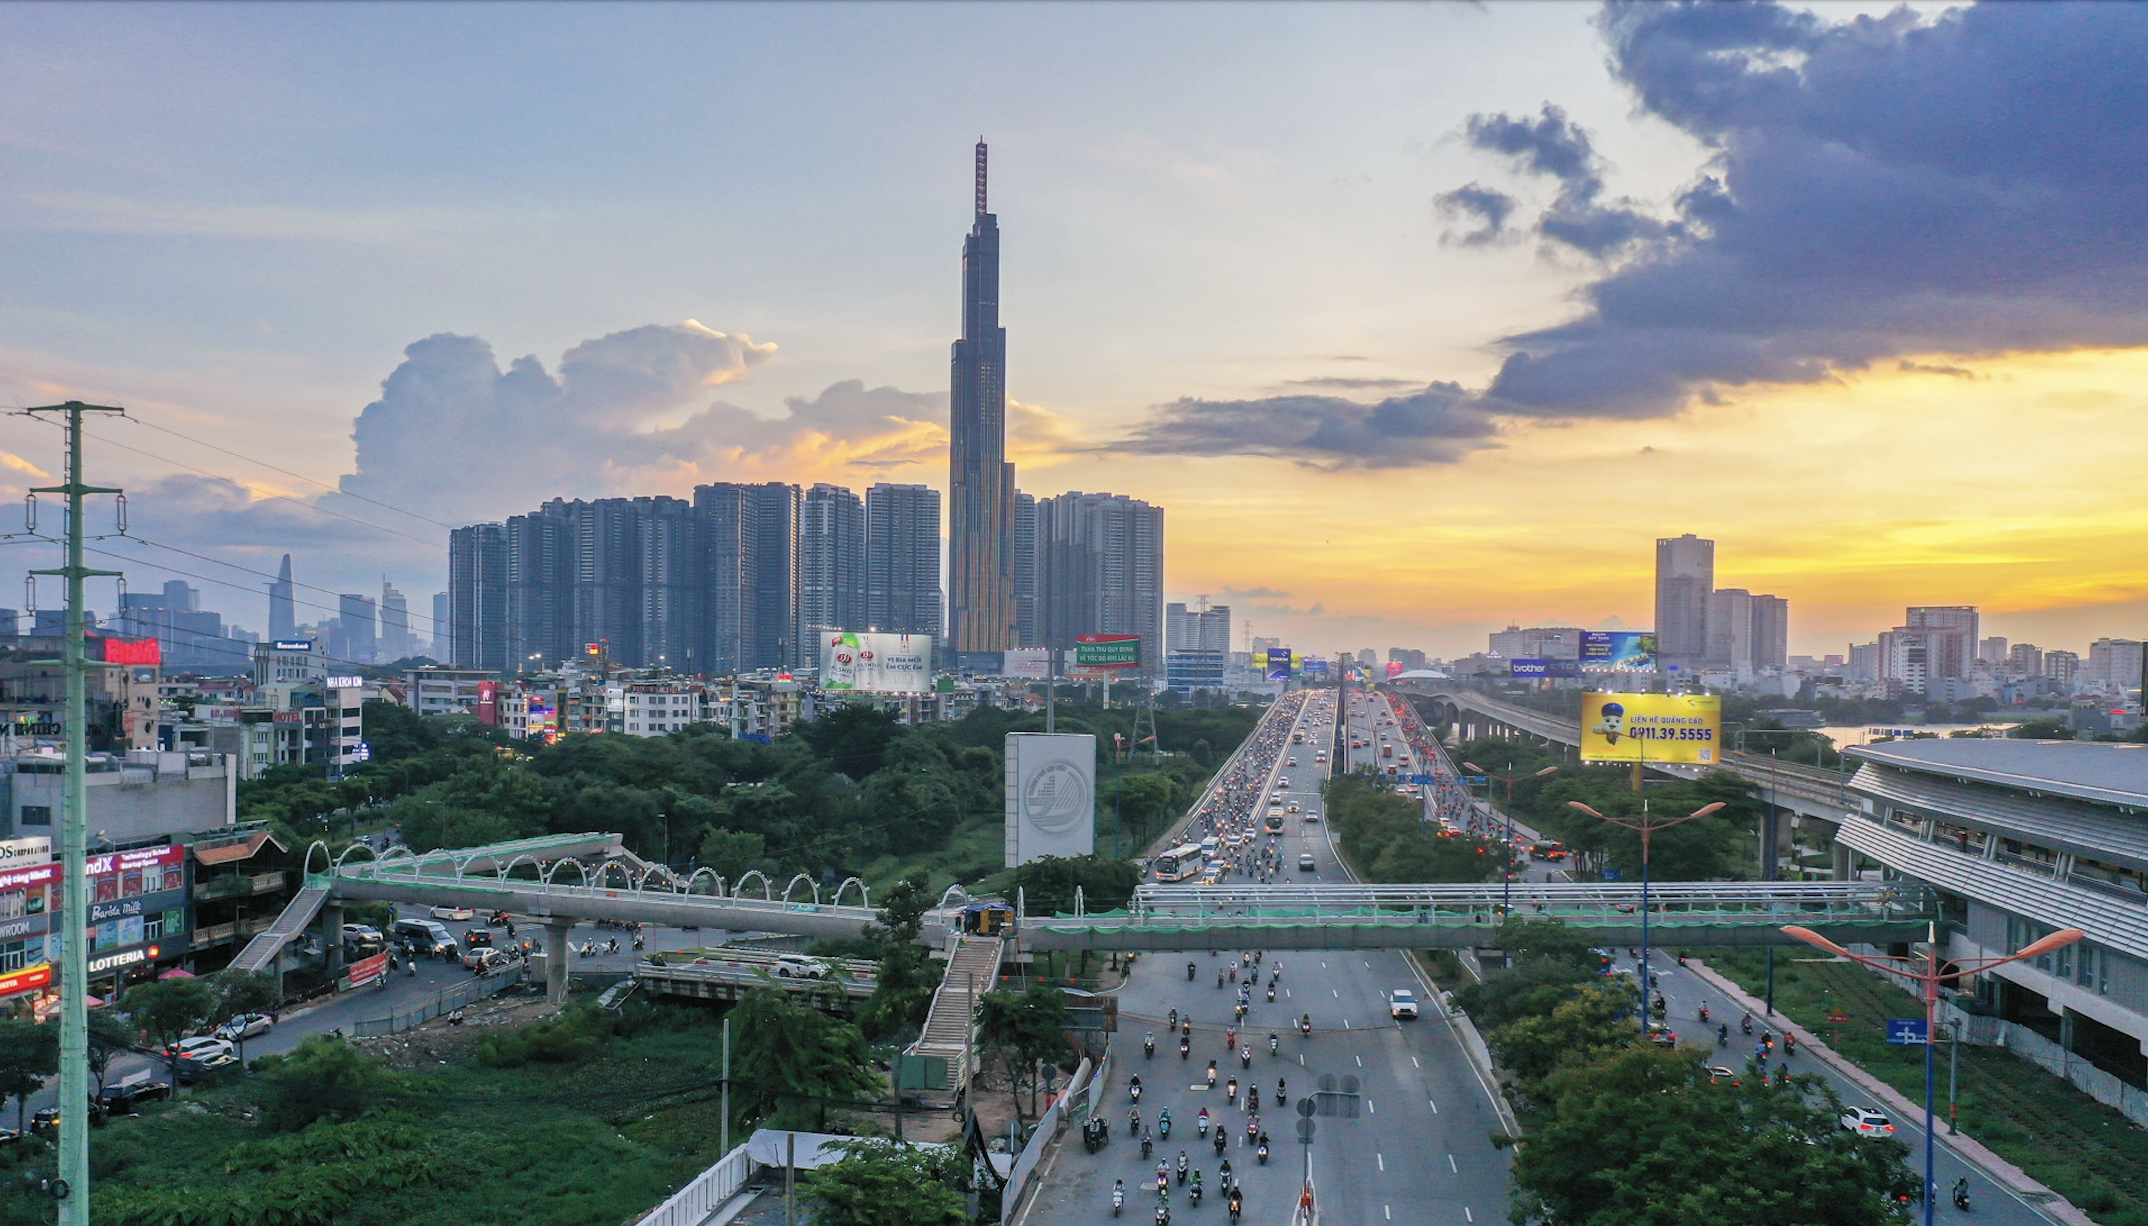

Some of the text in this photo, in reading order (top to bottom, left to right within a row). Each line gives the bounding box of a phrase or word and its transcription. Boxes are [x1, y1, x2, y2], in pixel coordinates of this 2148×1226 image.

[1513, 664, 1545, 673] brother
[327, 677, 338, 688] NHA
[275, 712, 302, 723] HOTEL
[1630, 716, 1647, 724] LIÊN
[1629, 727, 1712, 741] 0911.39.5555
[14, 845, 49, 857] CORPORATION
[121, 847, 170, 861] Technology School
[120, 858, 159, 870] Startup Space
[30, 868, 52, 880] MindX
[88, 950, 145, 972] LOTTERIA
